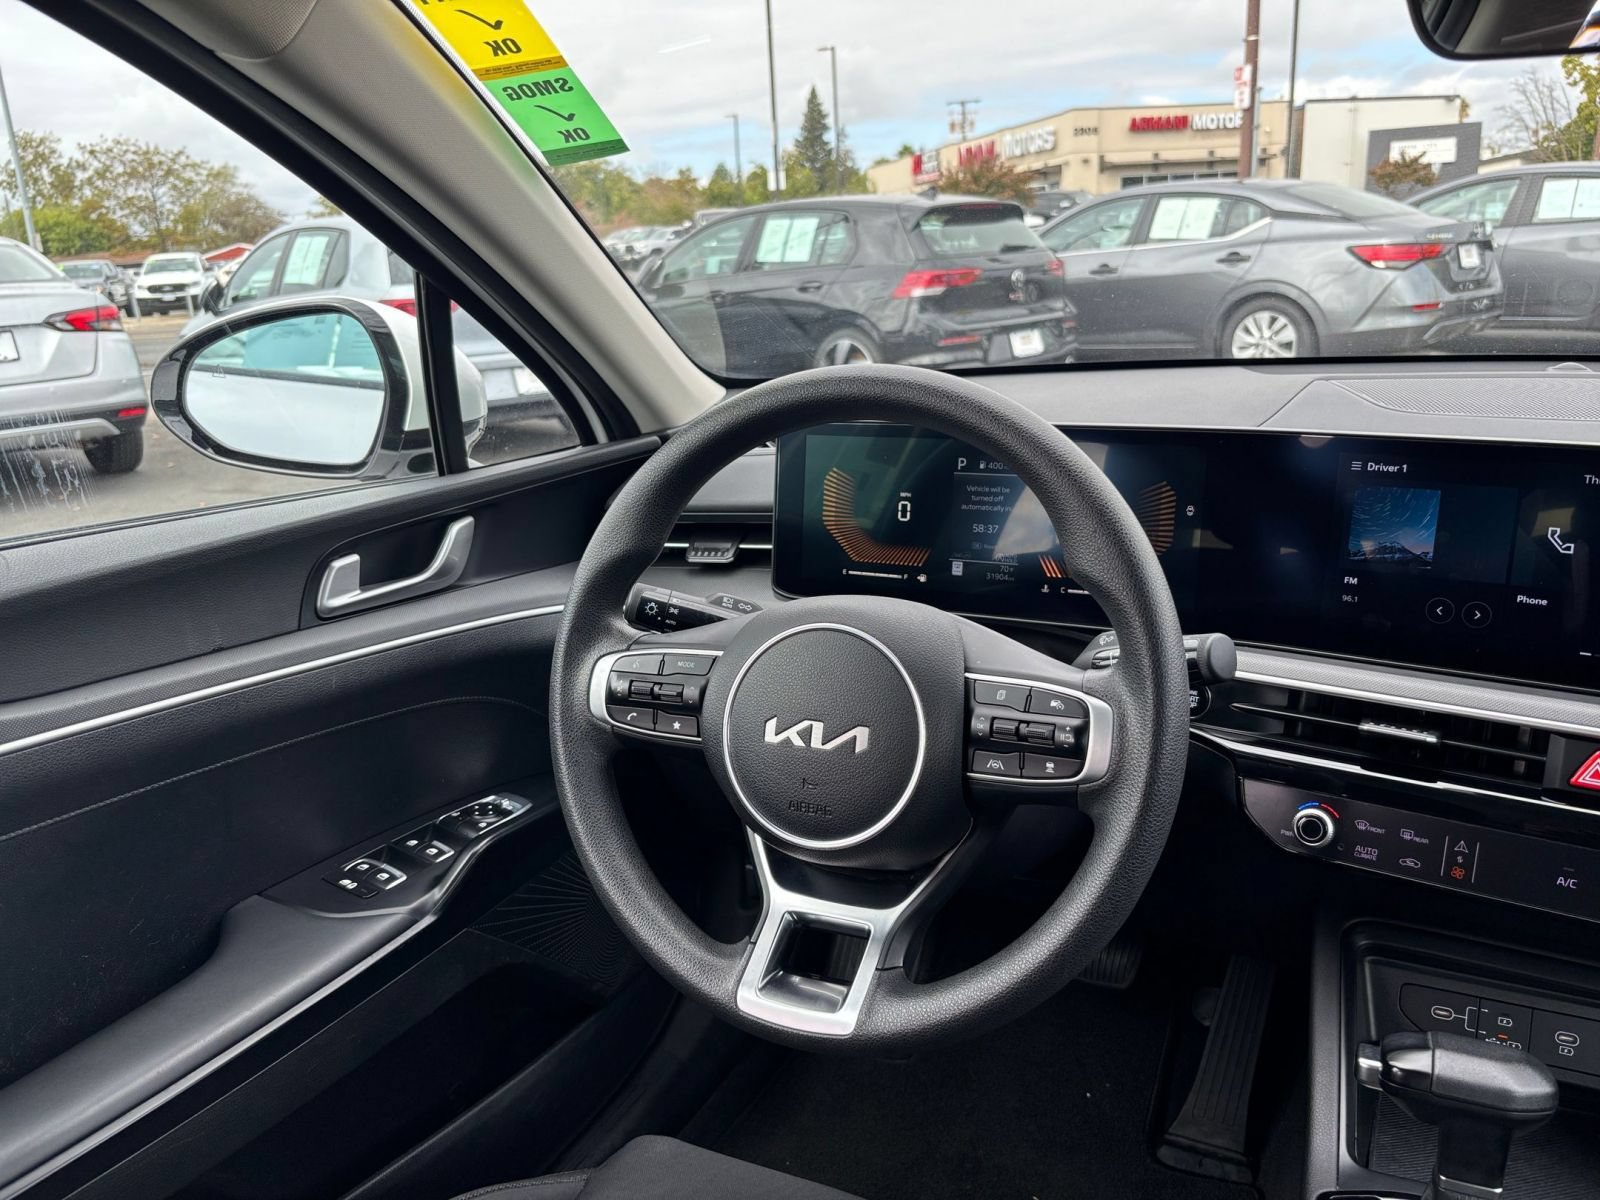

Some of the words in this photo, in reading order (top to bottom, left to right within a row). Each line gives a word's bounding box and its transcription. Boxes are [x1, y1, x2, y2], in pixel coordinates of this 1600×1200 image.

[957, 457, 967, 470] P
[1367, 462, 1399, 473] Driver
[1401, 463, 1407, 473] 1
[1584, 474, 1600, 485] Th
[897, 500, 911, 522] 0
[961, 504, 1004, 512] automatically
[972, 523, 999, 534] 58:37
[1344, 576, 1358, 585] FM
[1341, 594, 1359, 603] 96.1
[1516, 595, 1548, 606] Phone
[764, 716, 870, 754] KIA
[787, 799, 833, 818] AIRBAG
[1367, 826, 1387, 834] FRONT
[1354, 845, 1378, 856] AUTO
[1556, 875, 1578, 889] A/C
